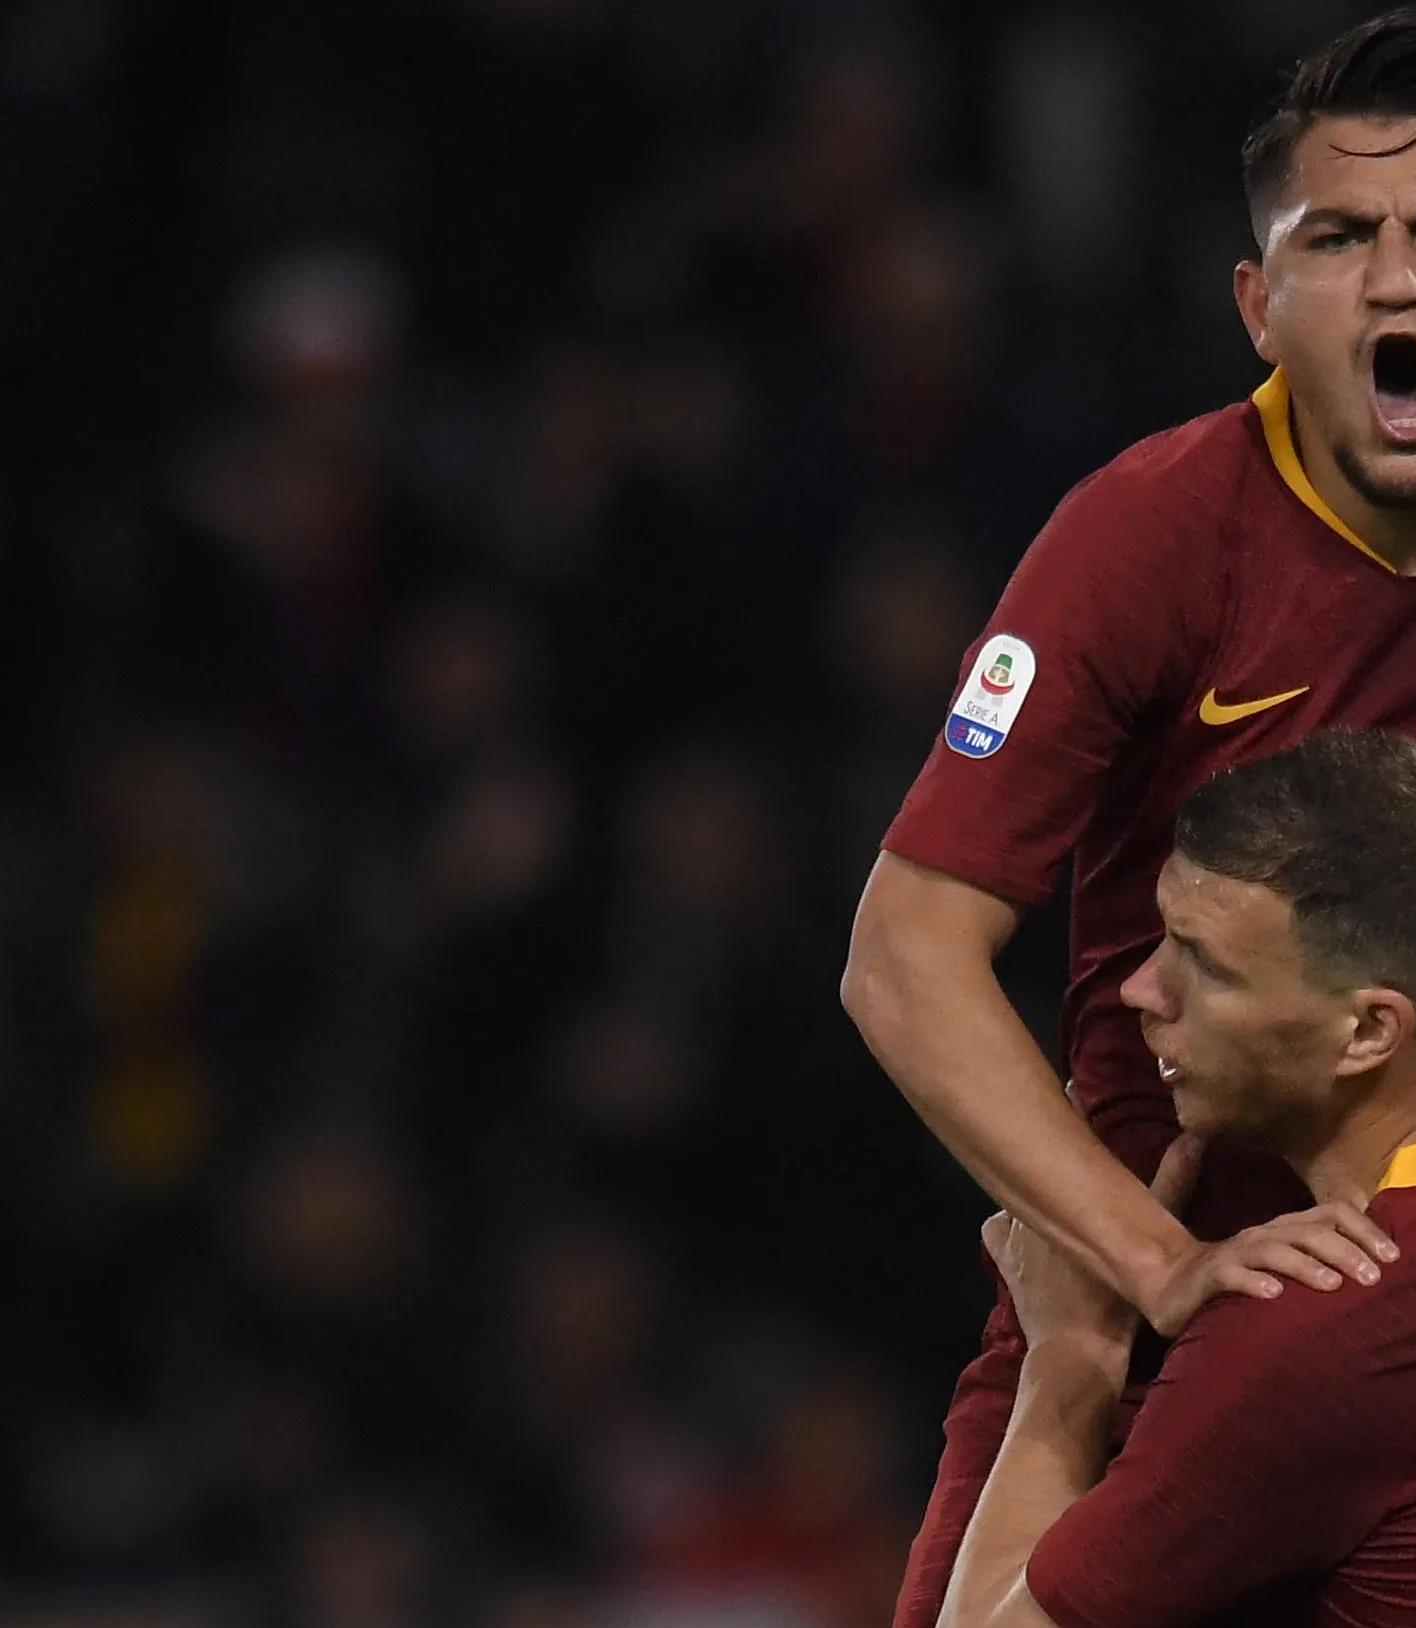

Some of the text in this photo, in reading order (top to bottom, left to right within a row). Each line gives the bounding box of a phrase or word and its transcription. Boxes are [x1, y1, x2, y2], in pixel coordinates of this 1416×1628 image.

[963, 700, 1000, 726] SERIE A
[965, 727, 993, 751] TIM
